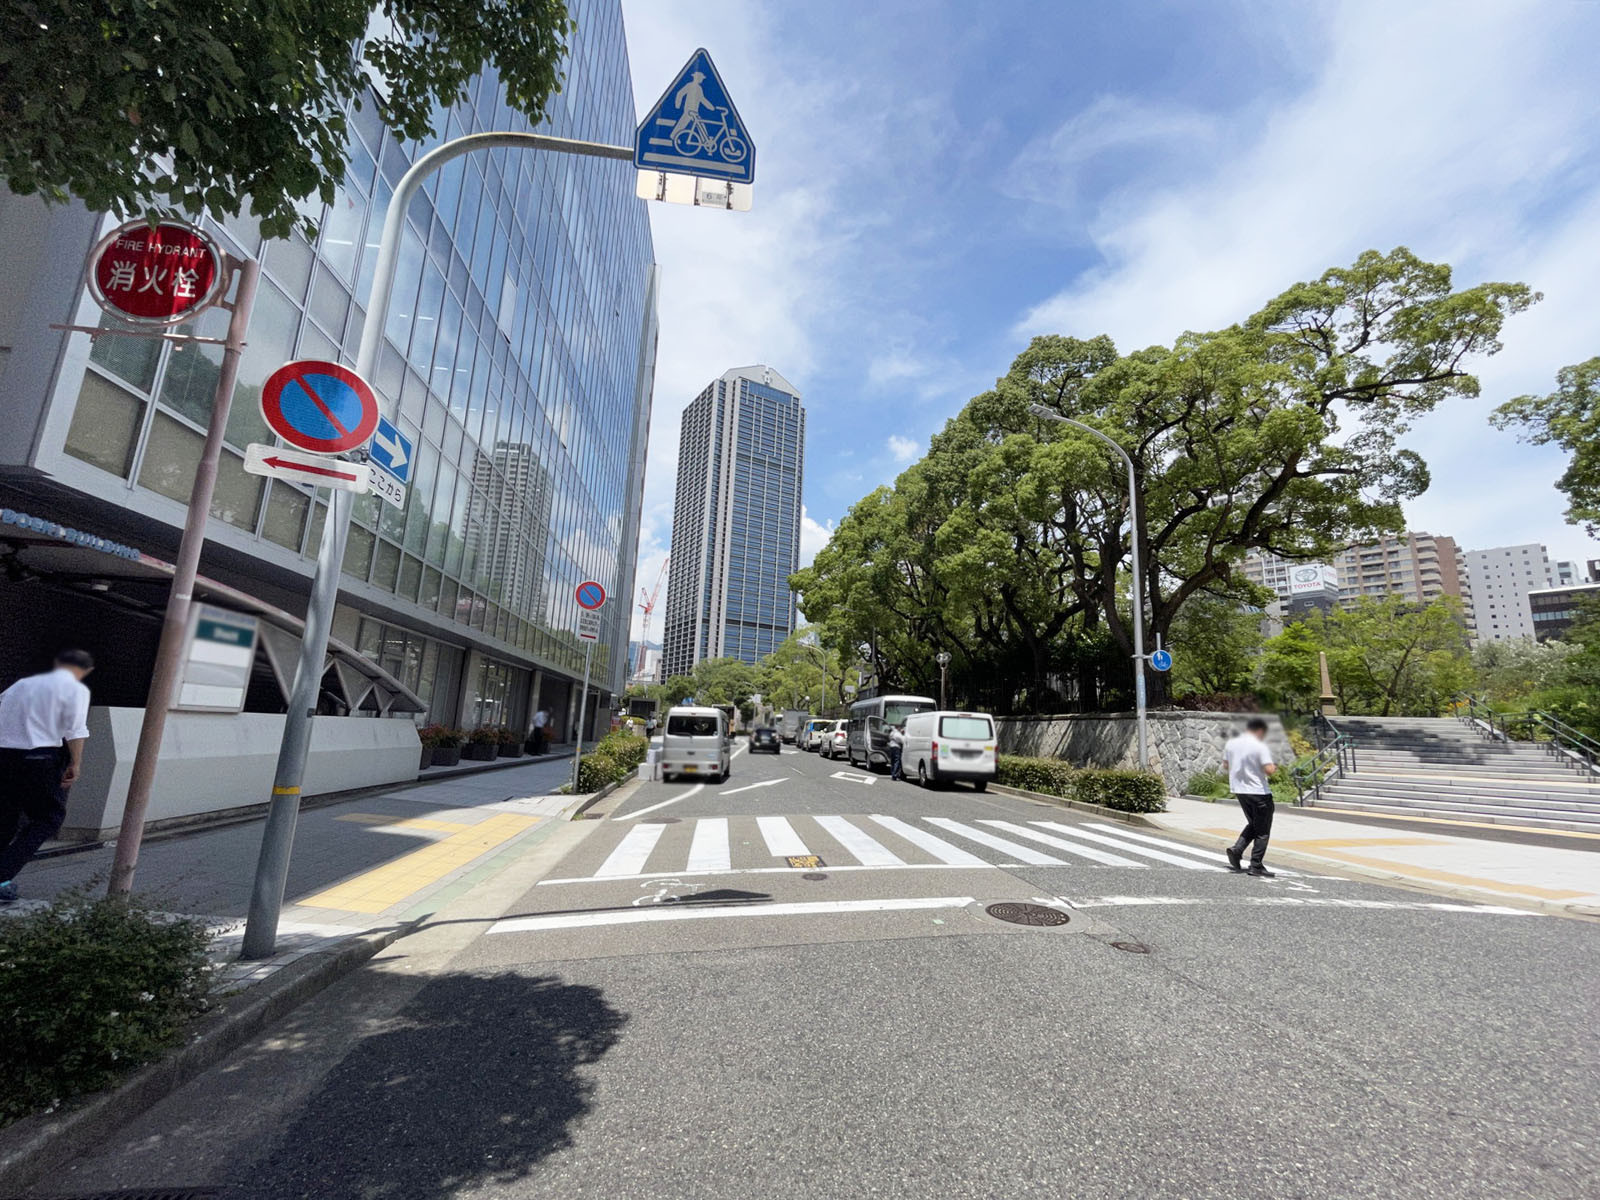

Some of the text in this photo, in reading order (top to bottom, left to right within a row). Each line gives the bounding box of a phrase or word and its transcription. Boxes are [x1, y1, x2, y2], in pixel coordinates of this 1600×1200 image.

[115, 239, 207, 259] FIRE HYDRANT
[106, 260, 200, 299] 消火栓
[368, 468, 402, 502] ここから
[1293, 581, 1321, 590] TOYOTA
